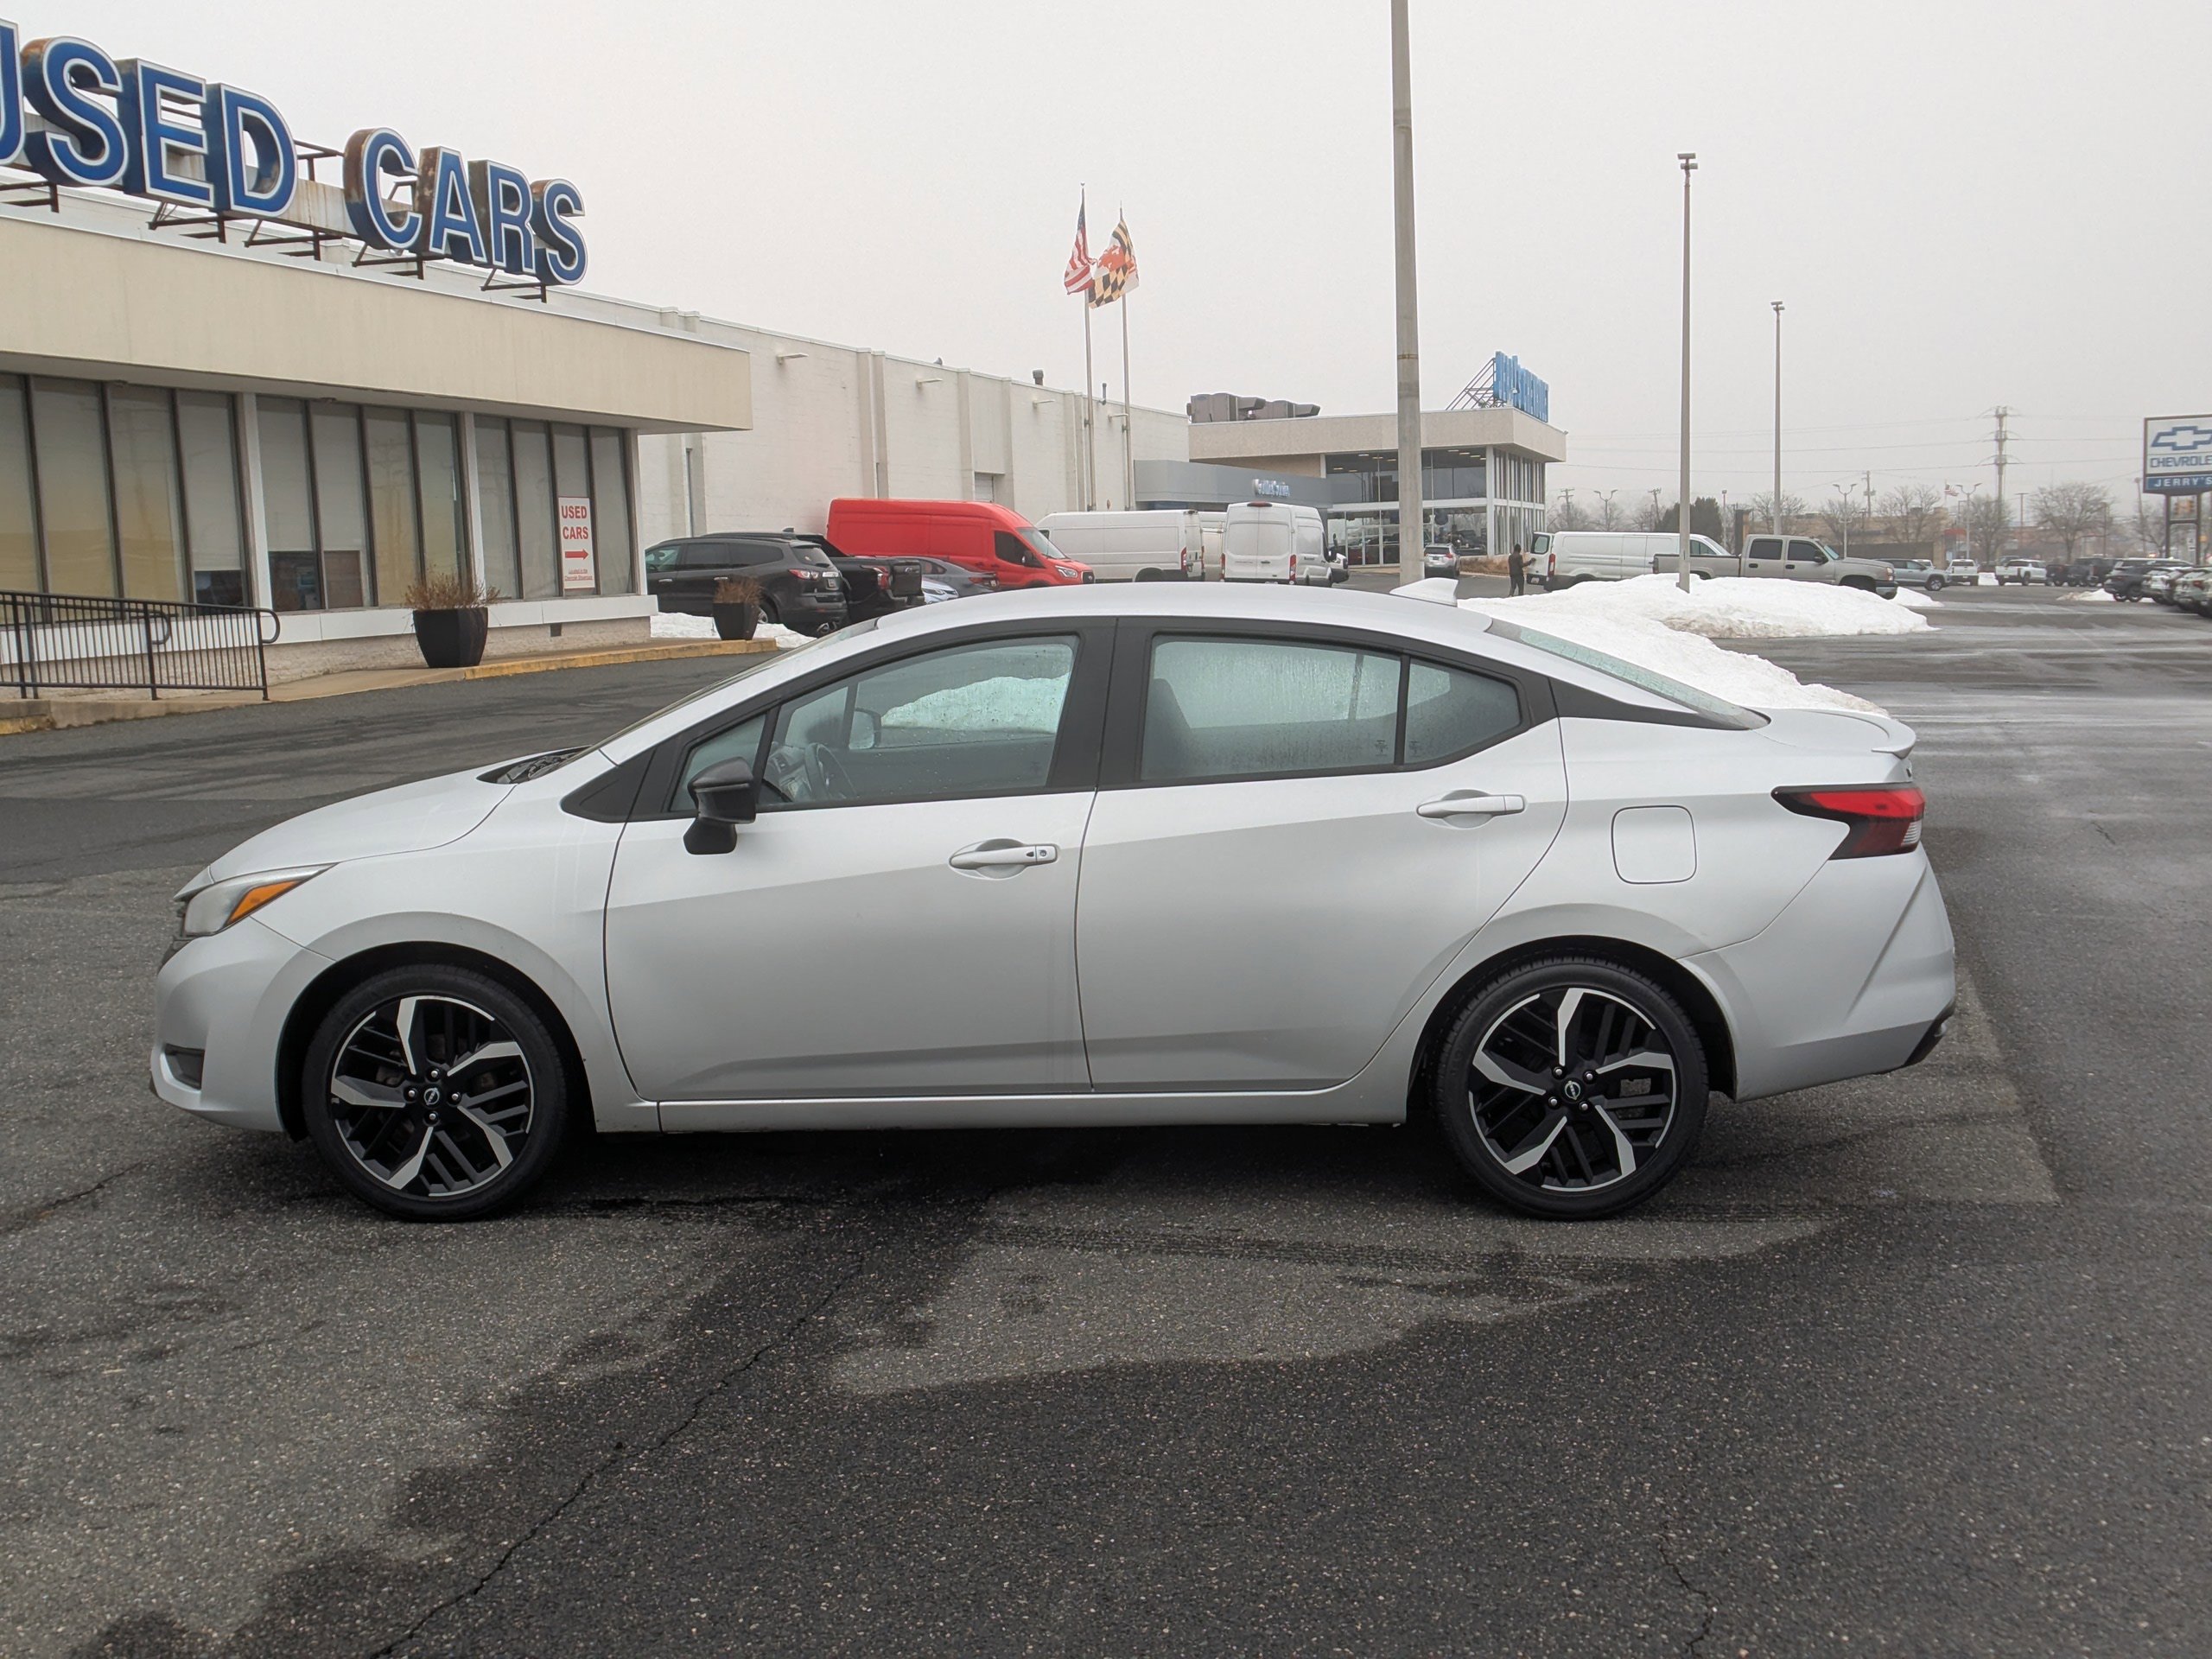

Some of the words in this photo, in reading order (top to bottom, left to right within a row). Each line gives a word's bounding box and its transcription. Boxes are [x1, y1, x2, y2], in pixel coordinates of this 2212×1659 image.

[344, 127, 588, 286] CARS
[2154, 476, 2212, 487] JERRY'S
[561, 505, 588, 519] USED
[563, 526, 589, 540] CARS
